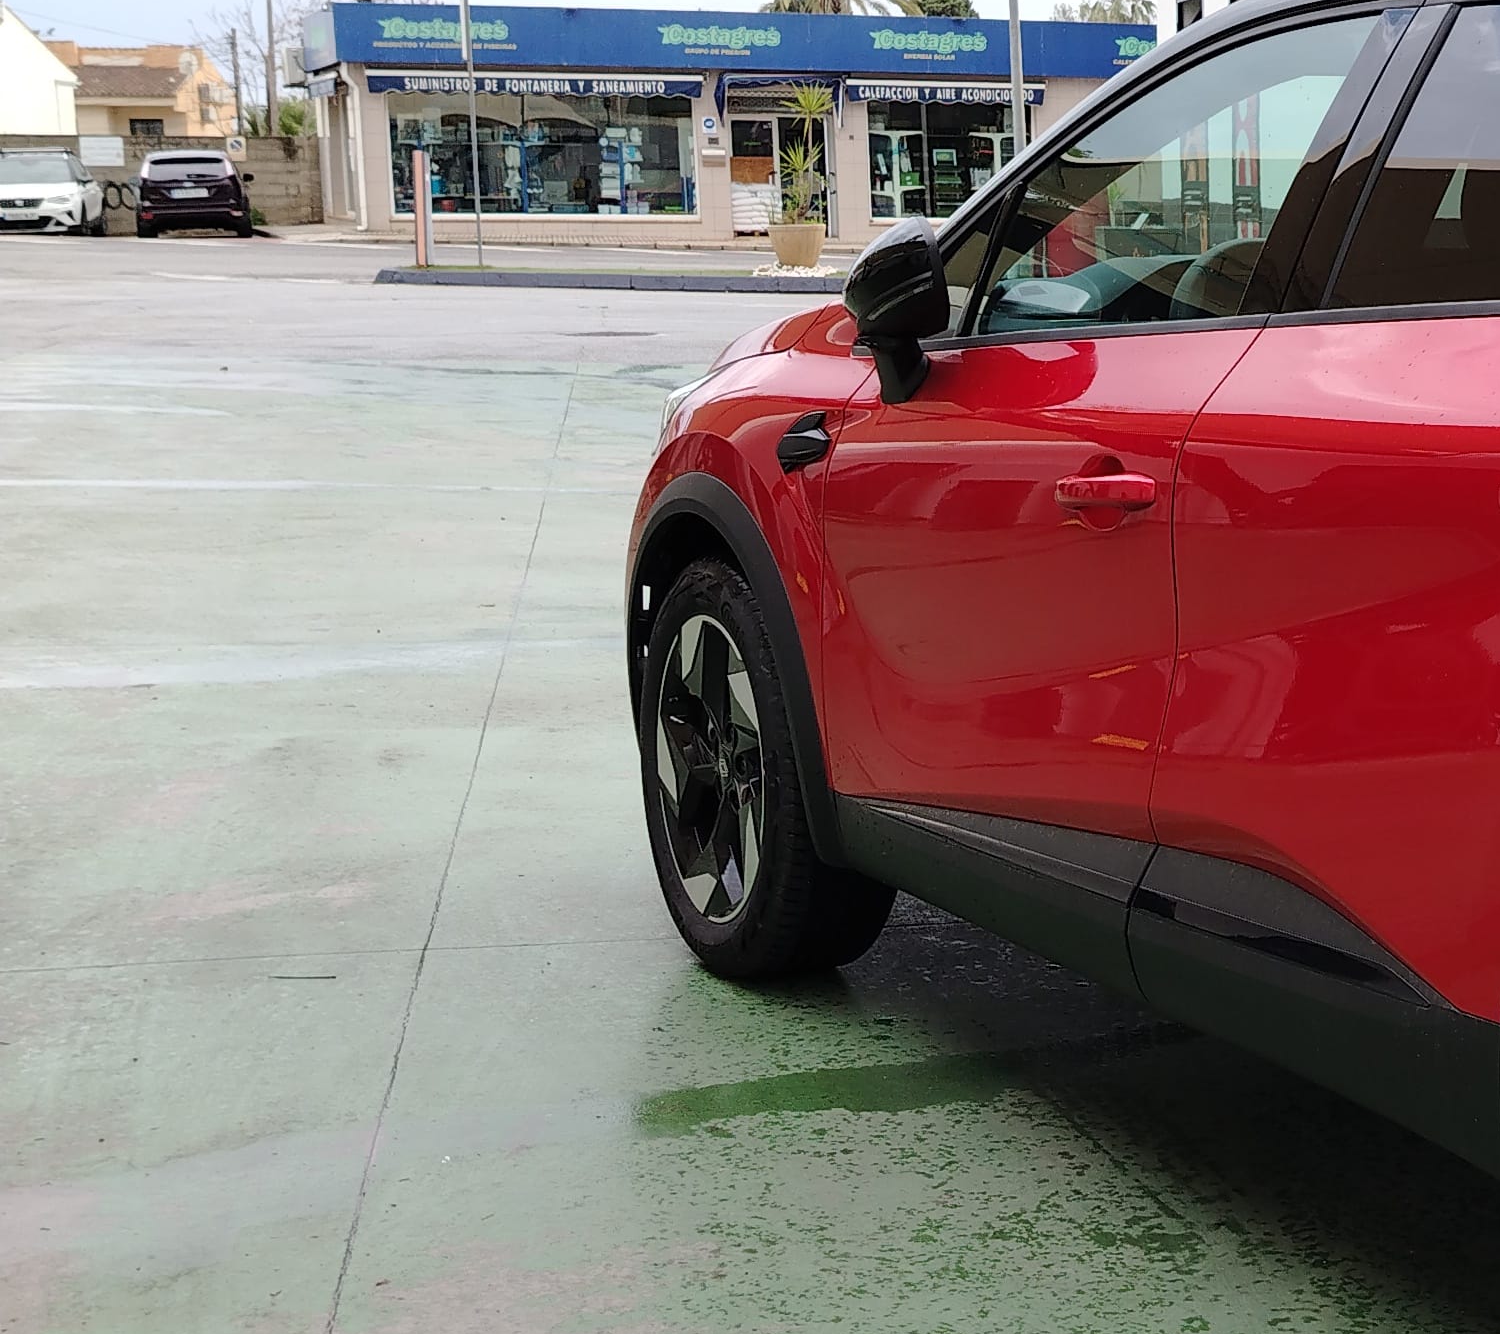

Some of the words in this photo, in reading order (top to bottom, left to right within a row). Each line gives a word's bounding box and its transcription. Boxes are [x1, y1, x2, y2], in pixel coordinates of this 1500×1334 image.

[658, 24, 781, 49] Costagres
[870, 29, 987, 54] Costagres
[484, 79, 498, 92] DE
[505, 78, 571, 93] FONTANERIA
[578, 80, 585, 93] Y
[592, 80, 665, 94] SANEAMIENTO
[858, 86, 919, 99] CALEFACCION
[924, 87, 931, 99] Y
[936, 87, 956, 100] AIRE
[961, 88, 1034, 102] ACONDICIODO
